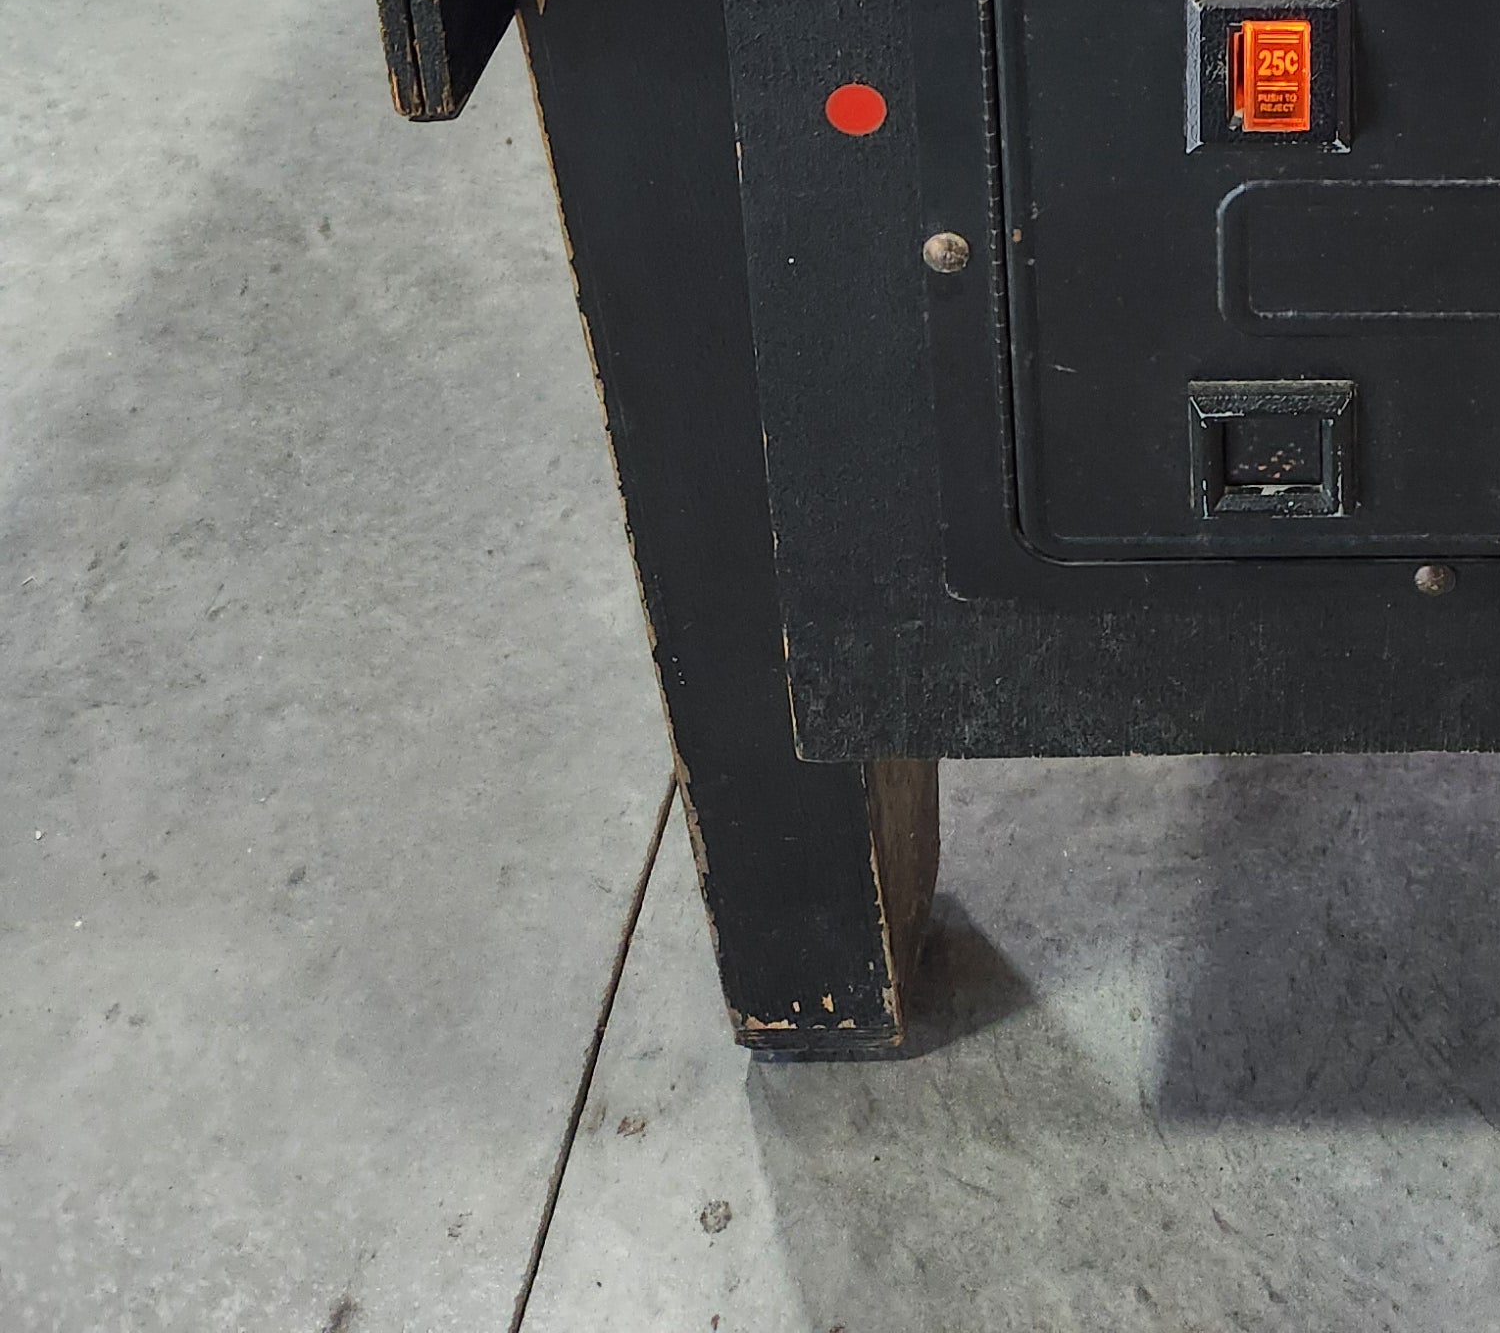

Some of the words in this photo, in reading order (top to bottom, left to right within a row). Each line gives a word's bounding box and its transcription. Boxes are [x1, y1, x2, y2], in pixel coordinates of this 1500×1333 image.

[1258, 49, 1299, 76] 25¢
[1257, 93, 1283, 102] PUSH
[1285, 93, 1298, 103] TO
[1260, 103, 1295, 112] REJECT
